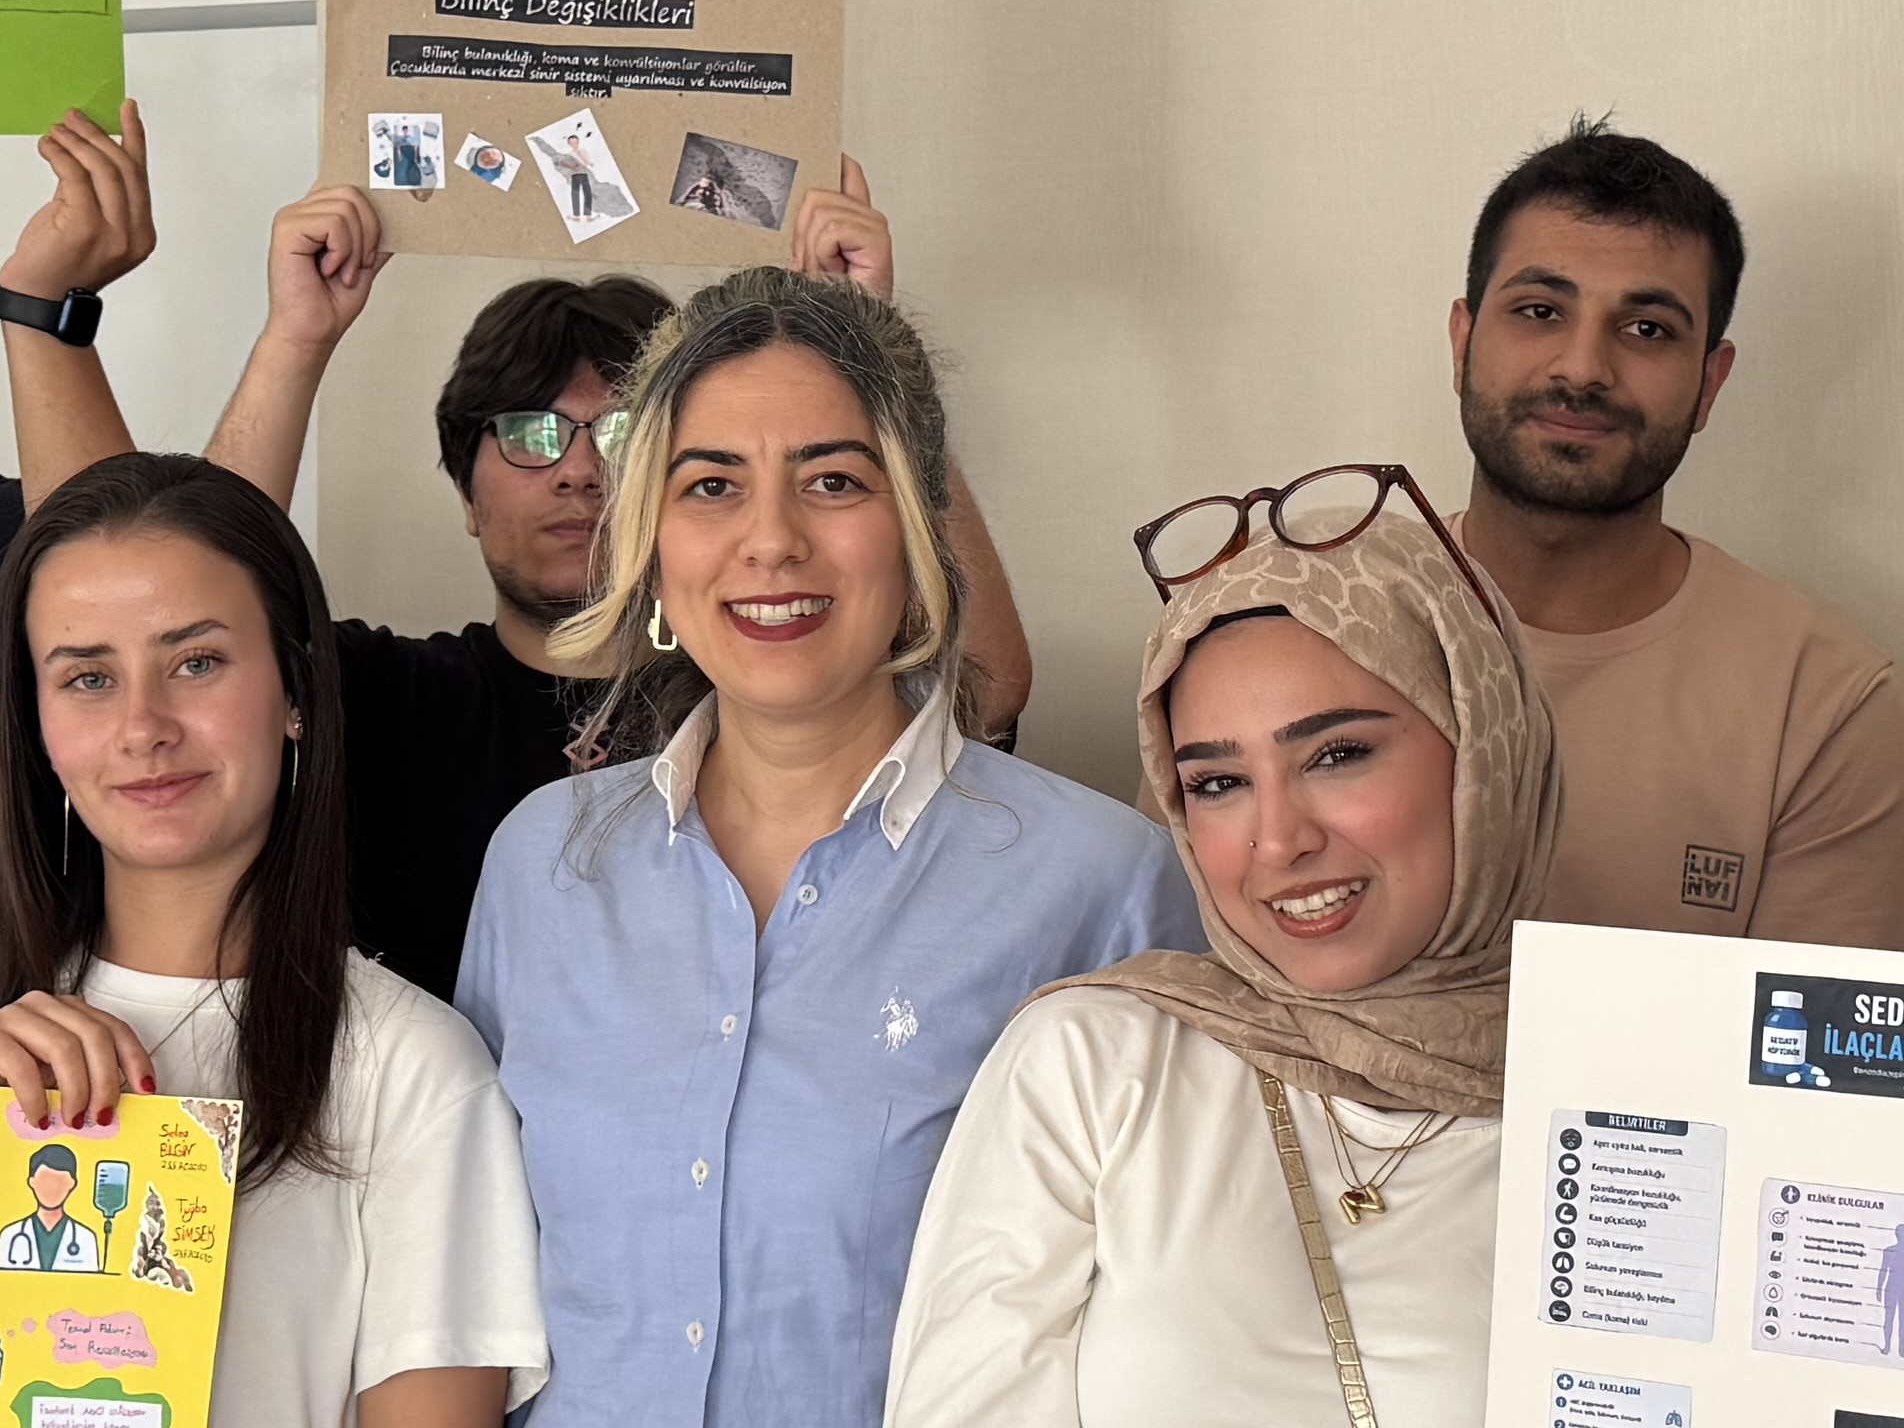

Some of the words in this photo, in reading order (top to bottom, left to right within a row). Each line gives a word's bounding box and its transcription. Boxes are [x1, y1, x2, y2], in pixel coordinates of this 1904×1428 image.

[422, 45, 459, 62] Bilinç
[542, 52, 579, 66] koma
[584, 56, 599, 66] ve
[604, 54, 701, 72] konvülsiyonlar
[390, 60, 466, 75] Çocuklarda
[471, 64, 525, 78] merkezi
[529, 67, 559, 80] sinir
[564, 70, 611, 82] sistemi
[690, 78, 704, 87] ve
[710, 78, 787, 93] konvülsiyon
[1688, 853, 1738, 880] LUF
